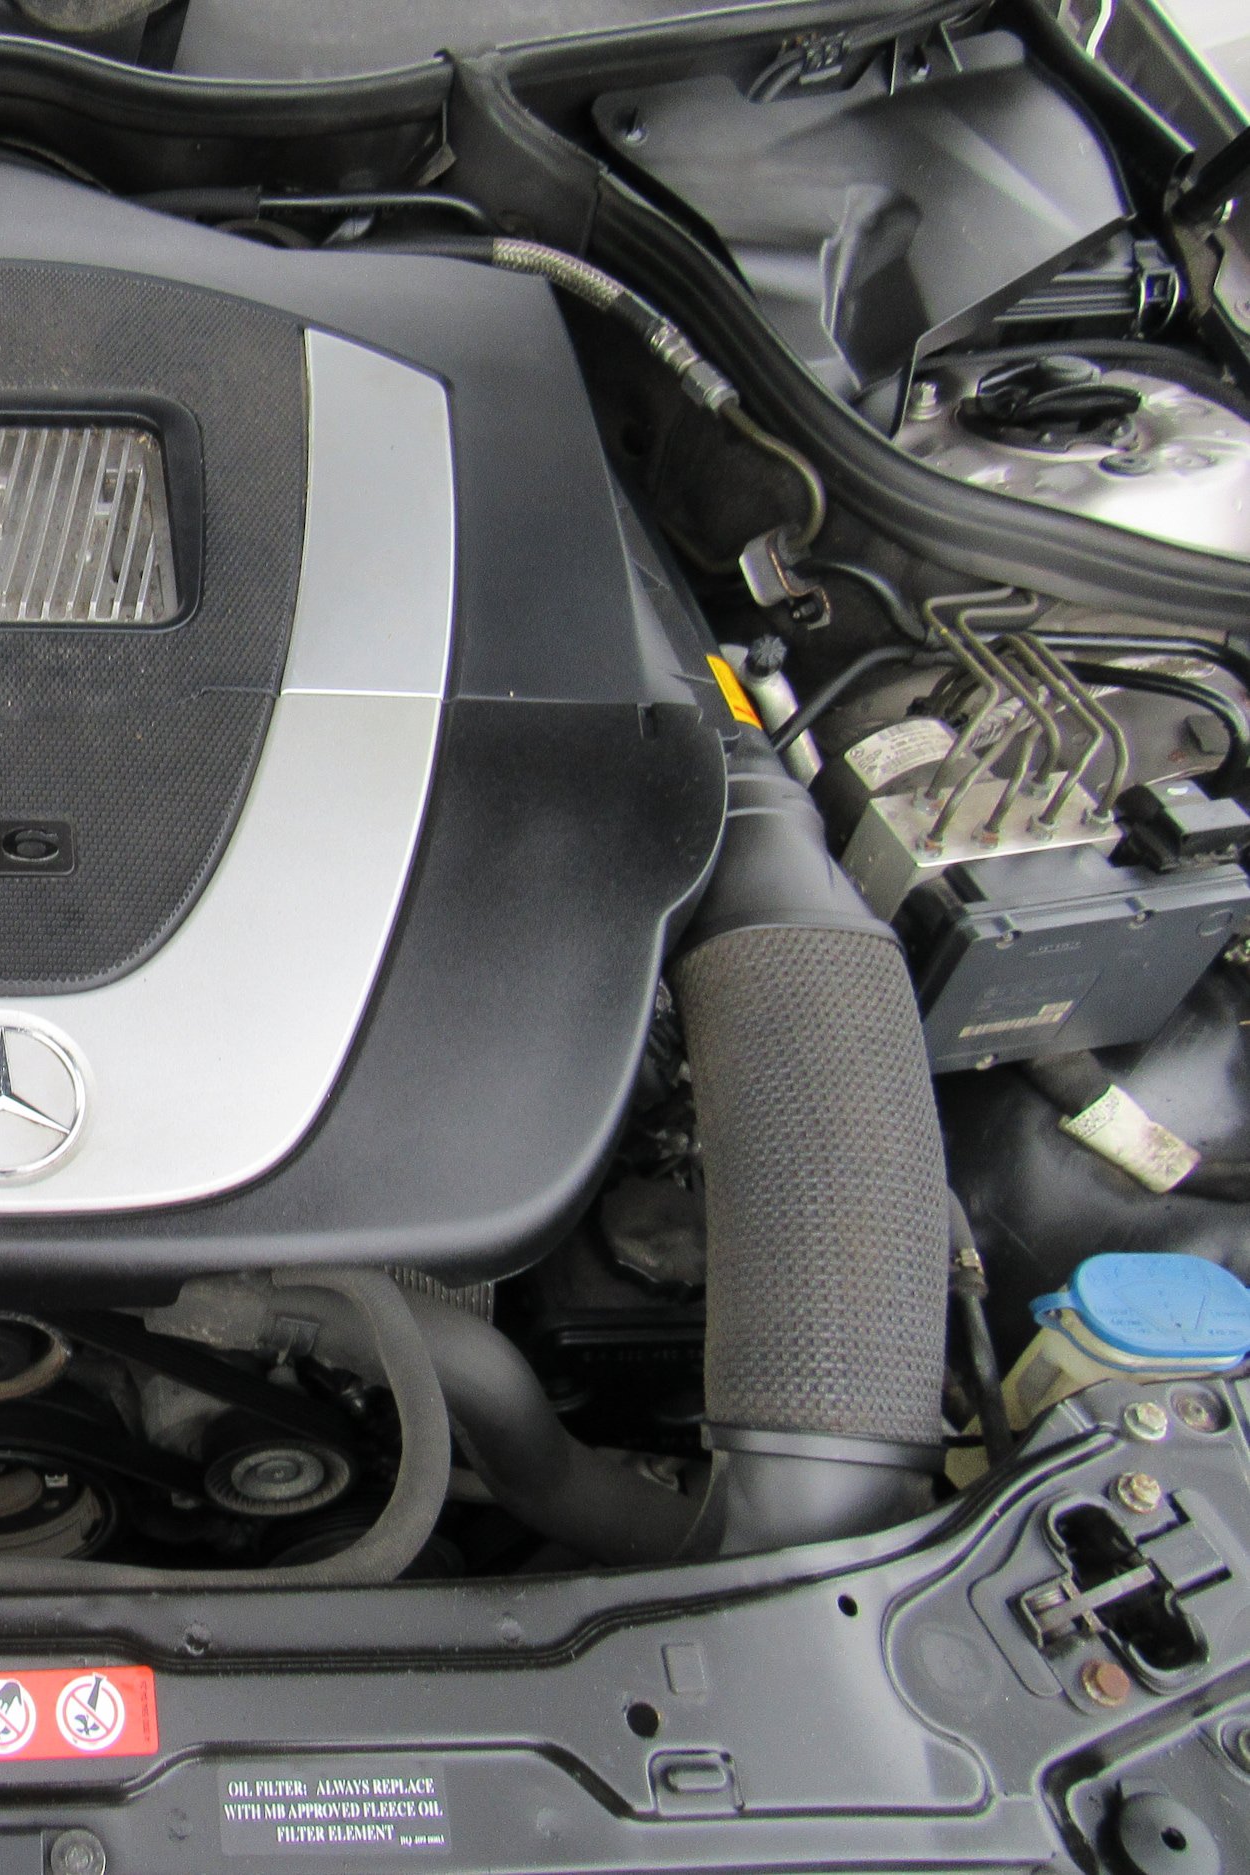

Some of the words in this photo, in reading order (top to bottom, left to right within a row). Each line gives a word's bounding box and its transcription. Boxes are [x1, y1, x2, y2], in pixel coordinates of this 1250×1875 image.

[228, 1780, 253, 1797] OIL
[255, 1780, 307, 1797] FILTER:
[316, 1779, 370, 1796] ALWAYS
[372, 1778, 435, 1795] REPLACE
[224, 1803, 262, 1820] WITH
[264, 1803, 286, 1820] MB
[288, 1802, 361, 1820] APPROVED
[363, 1801, 416, 1818] FLEECE
[418, 1800, 444, 1817] OIL
[276, 1825, 325, 1843] FILTER
[328, 1824, 395, 1842] ELEMENT
